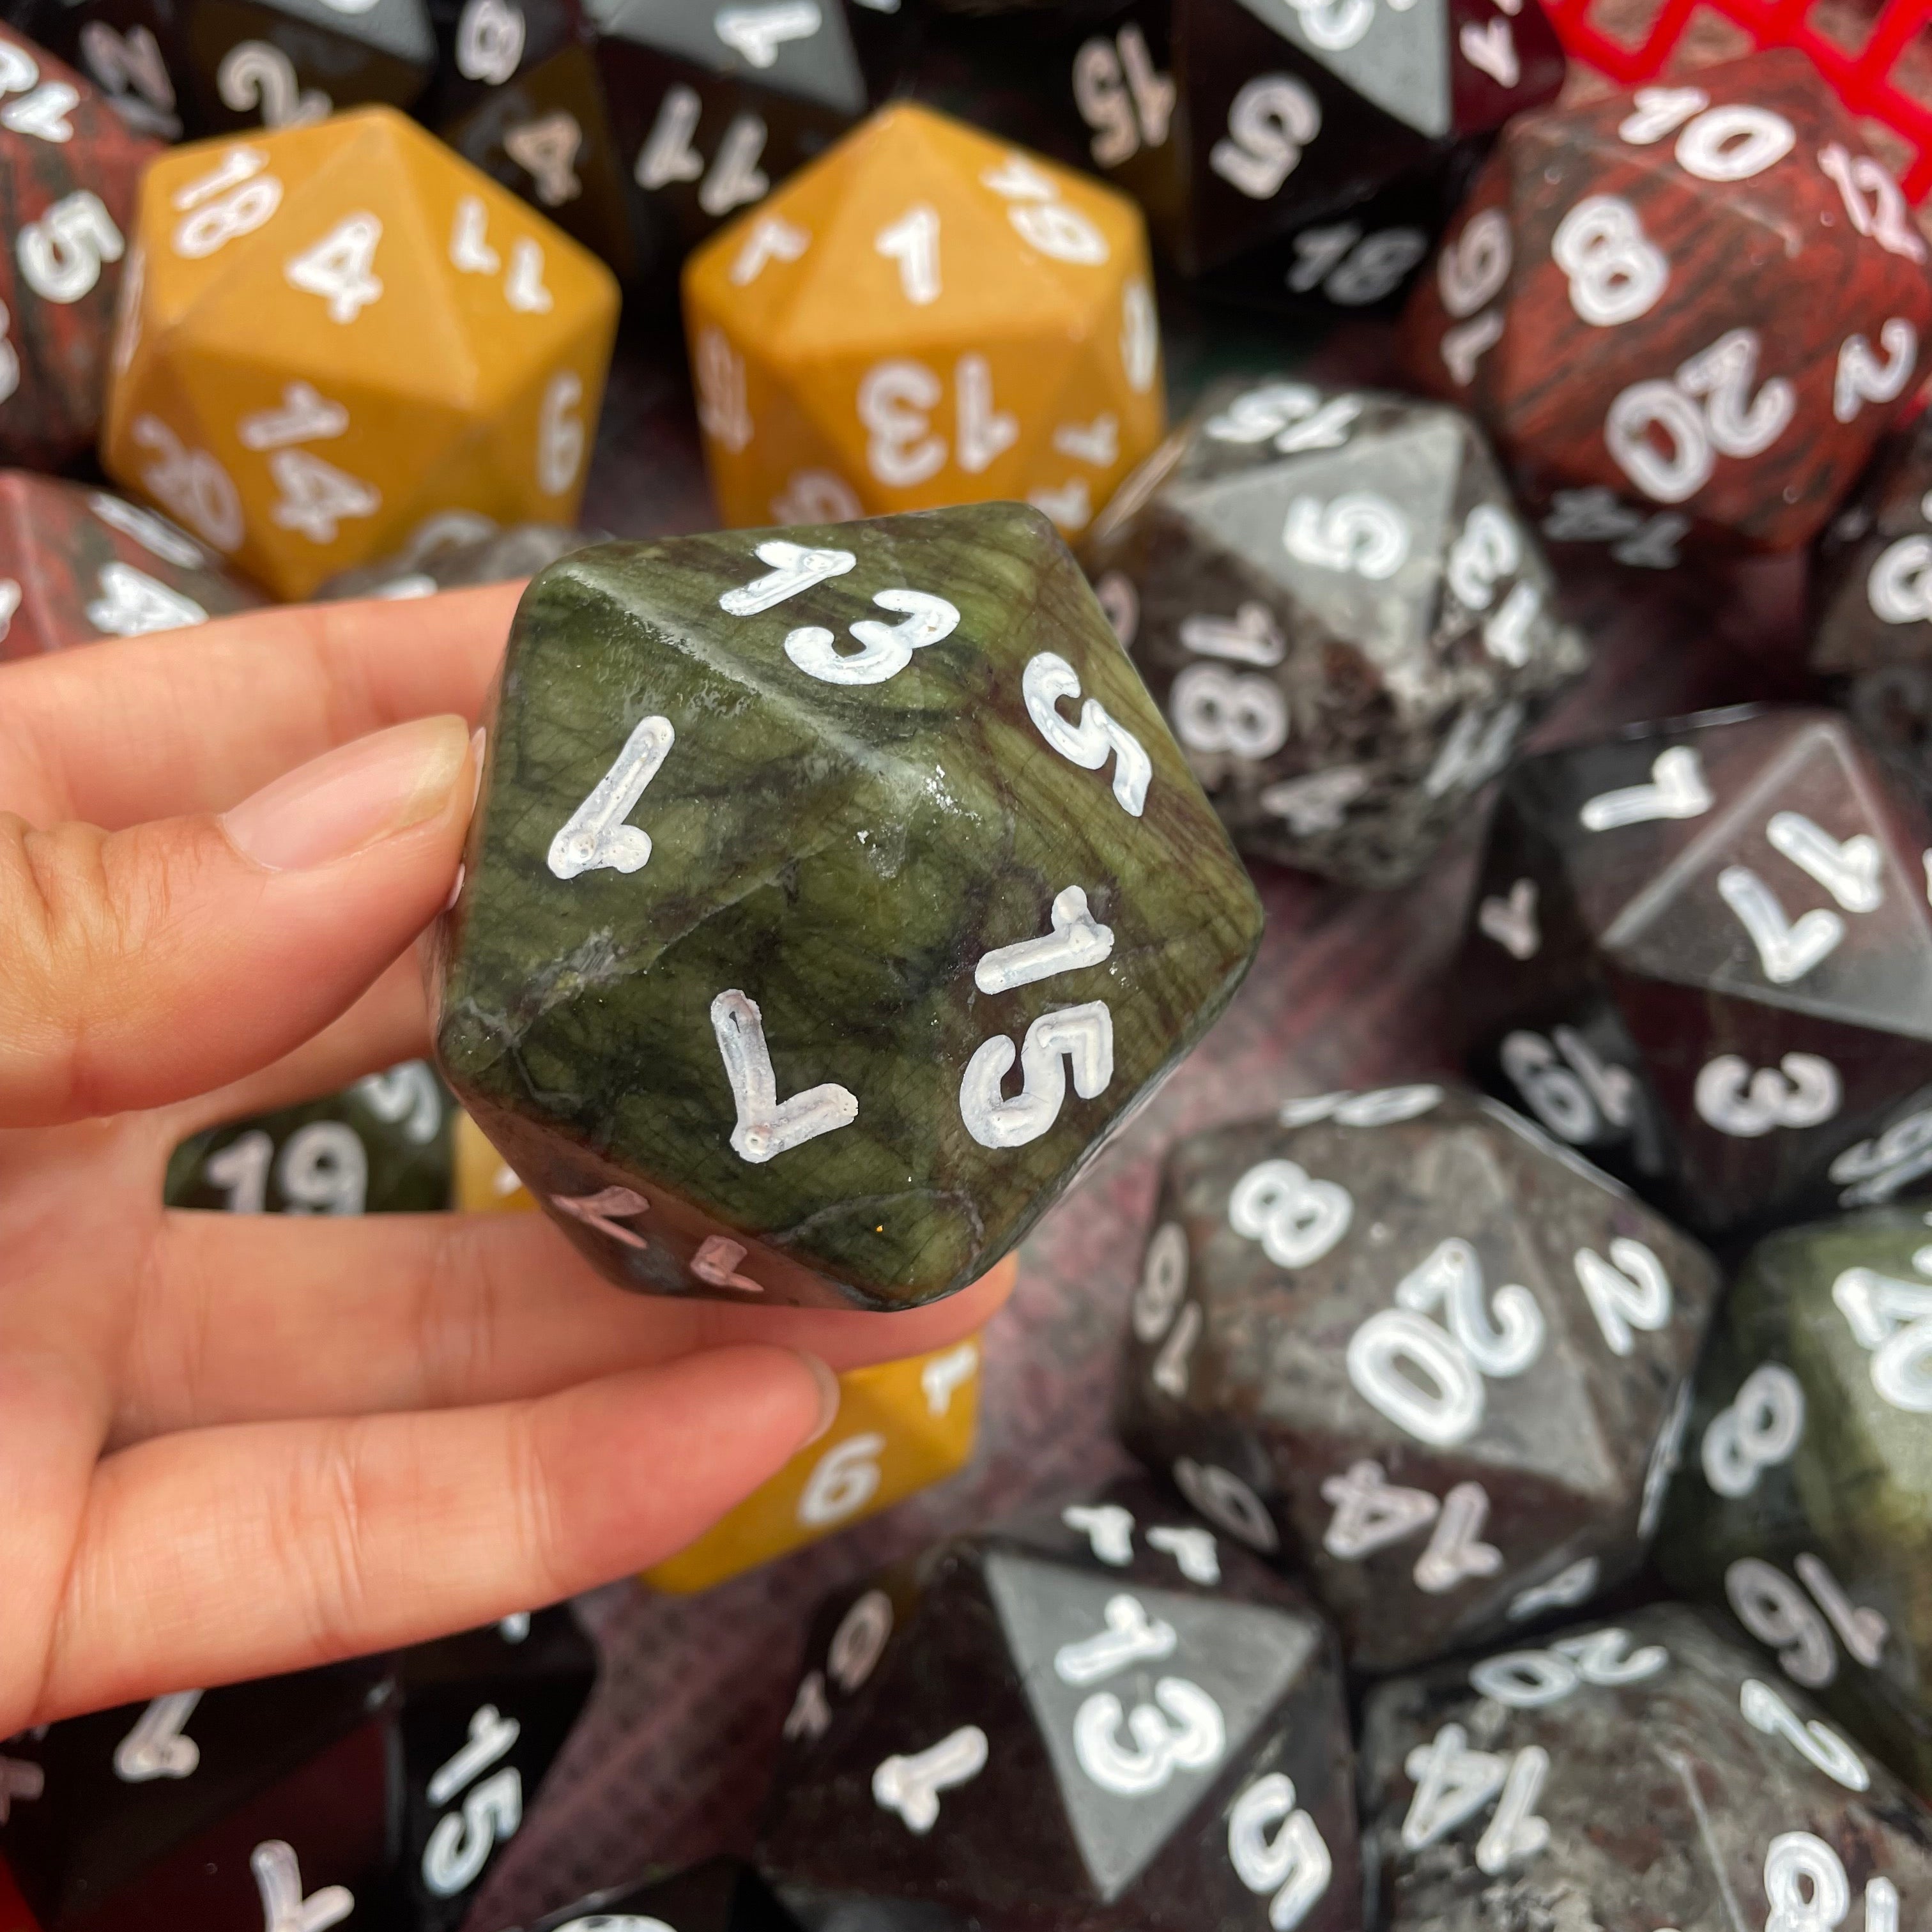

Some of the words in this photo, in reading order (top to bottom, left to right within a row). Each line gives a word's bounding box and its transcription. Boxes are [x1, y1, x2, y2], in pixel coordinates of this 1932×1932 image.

[1209, 73, 1322, 199] 5
[1618, 86, 1797, 182] 10
[17, 190, 125, 303] 5
[171, 144, 284, 259] 18
[284, 211, 383, 323] 4
[451, 195, 553, 315] 11
[874, 206, 943, 305] 1
[1552, 195, 1670, 326] 8
[856, 359, 1020, 487] 13
[1604, 327, 1797, 503] 20
[1832, 319, 1917, 422] 2
[236, 381, 381, 543] 14
[1283, 491, 1409, 580] 5
[719, 540, 960, 686] 13
[1022, 651, 1153, 817] 5
[1169, 599, 1291, 760] 18
[547, 715, 675, 880] 1
[959, 885, 1115, 1149] 15
[1693, 1051, 1844, 1138] 3
[1229, 1158, 1354, 1269] 8
[1346, 1238, 1544, 1445] 20
[1574, 1237, 1674, 1357] 2
[1701, 1361, 1806, 1499] 8
[1321, 1459, 1504, 1594] 14
[1054, 1593, 1227, 1797] 13
[1468, 1626, 1670, 1709] 20
[420, 1703, 524, 1899] 15
[1227, 1771, 1333, 1932] 5
[1401, 1722, 1552, 1876] 14
